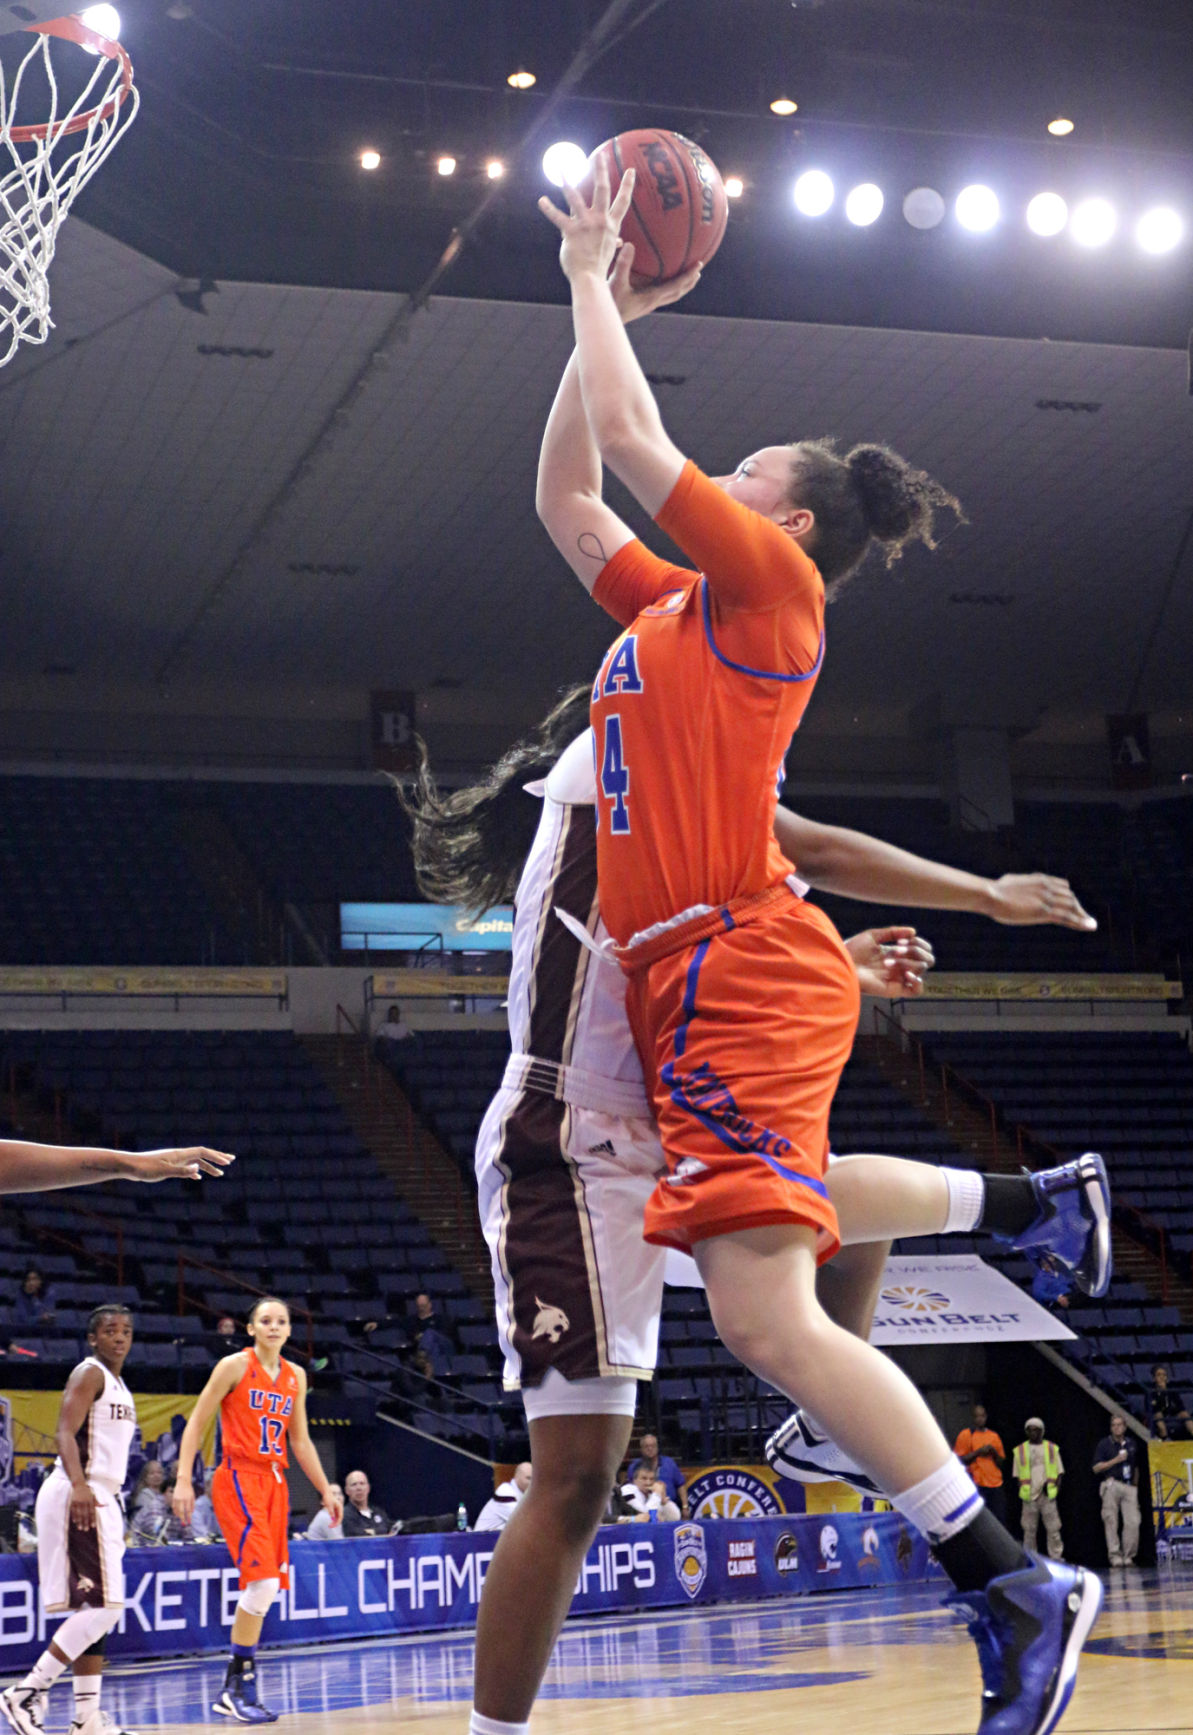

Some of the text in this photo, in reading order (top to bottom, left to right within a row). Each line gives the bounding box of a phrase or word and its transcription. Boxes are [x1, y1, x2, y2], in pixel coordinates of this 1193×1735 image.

[637, 141, 683, 212] NCAA
[939, 1313, 1021, 1325] BELT
[249, 1389, 293, 1416] UTA
[778, 1557, 798, 1571] ULM
